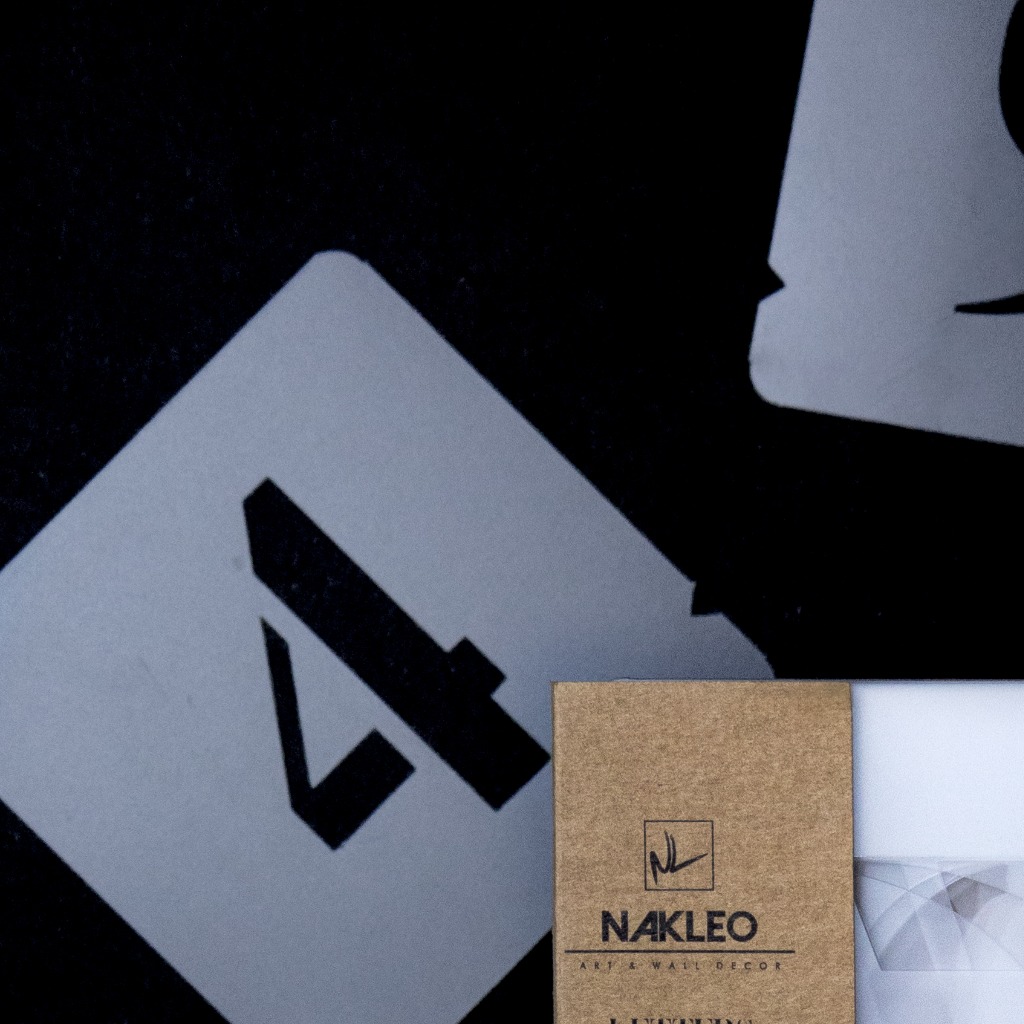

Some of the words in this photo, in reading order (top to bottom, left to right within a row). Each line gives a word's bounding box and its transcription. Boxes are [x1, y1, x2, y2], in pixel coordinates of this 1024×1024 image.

[242, 477, 551, 851] 4
[601, 910, 758, 942] NAKLEO
[579, 961, 613, 970] ART
[628, 961, 637, 970] &
[652, 961, 701, 970] WALL
[716, 961, 782, 970] DECOR
